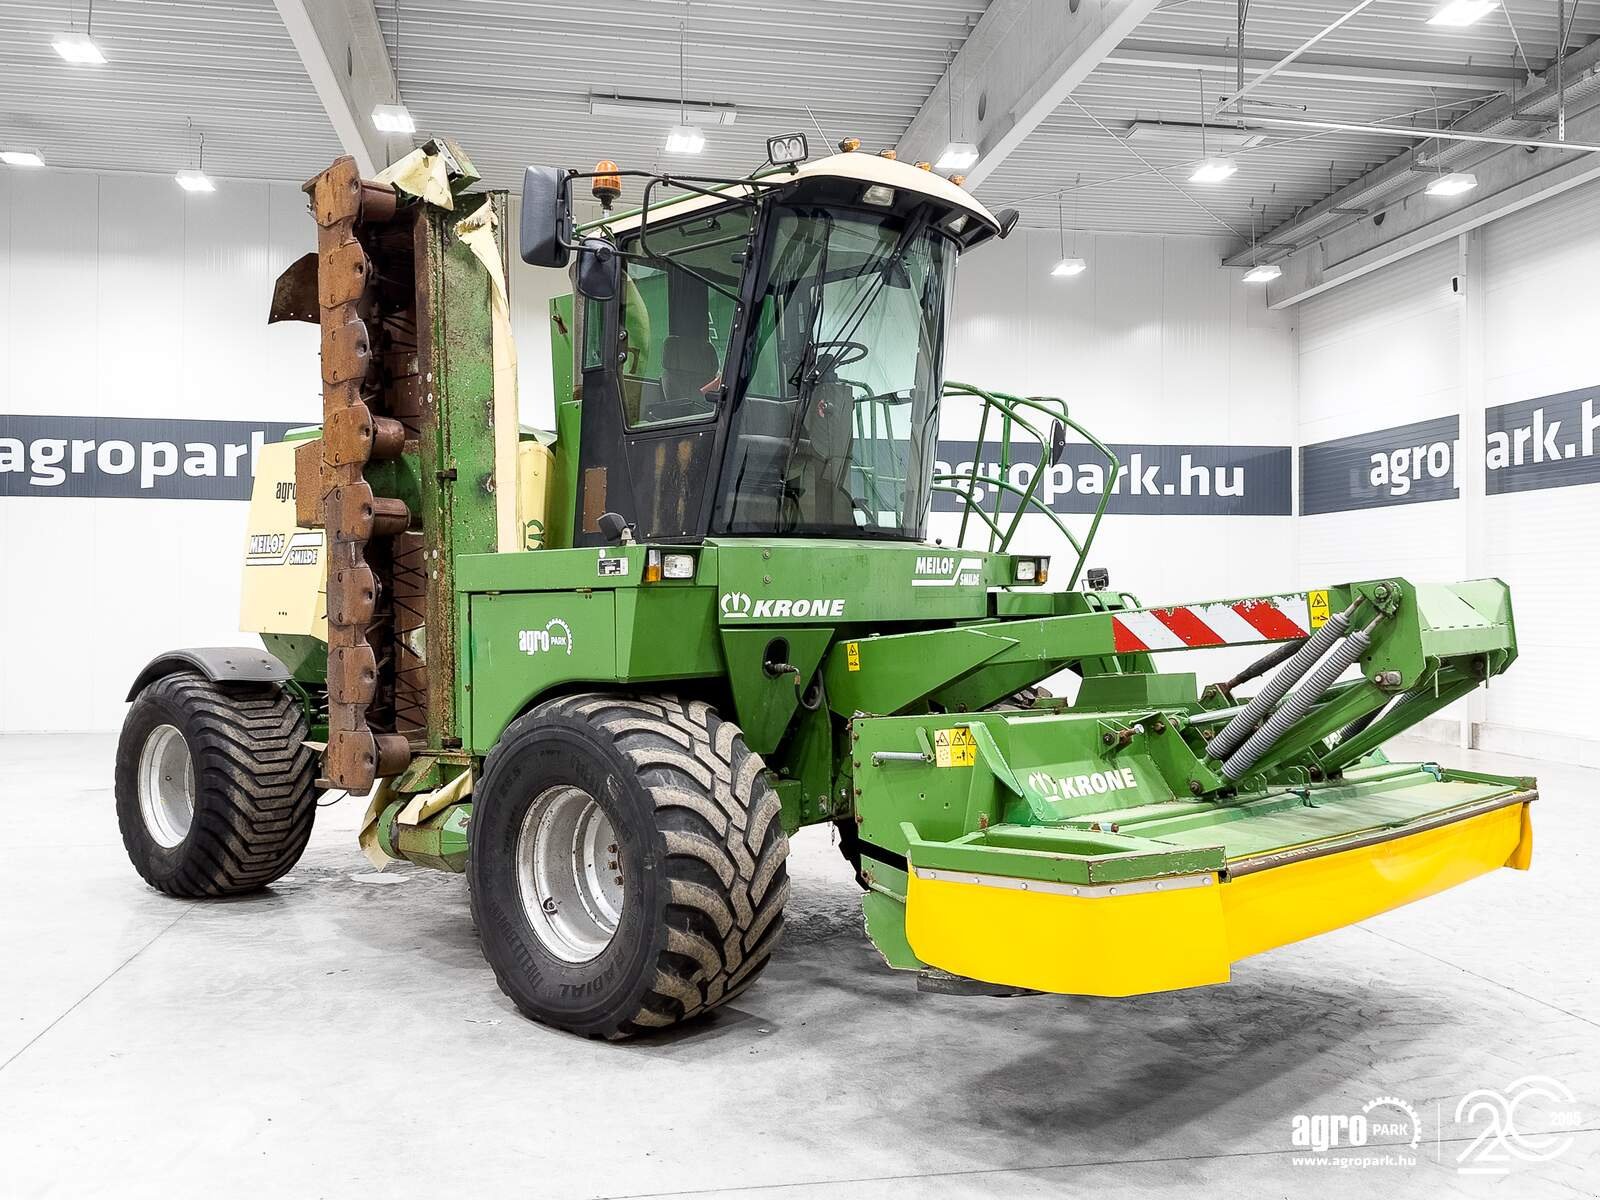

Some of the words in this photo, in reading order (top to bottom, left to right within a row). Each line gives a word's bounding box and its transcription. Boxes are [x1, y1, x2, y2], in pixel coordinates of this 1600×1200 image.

[248, 533, 286, 555] MEILOF
[288, 548, 319, 566] SMILDE
[915, 556, 955, 575] MEILOF
[752, 599, 846, 618] KRONE
[518, 630, 550, 656] agro
[550, 636, 567, 646] PARK
[1058, 767, 1138, 800] KRONE
